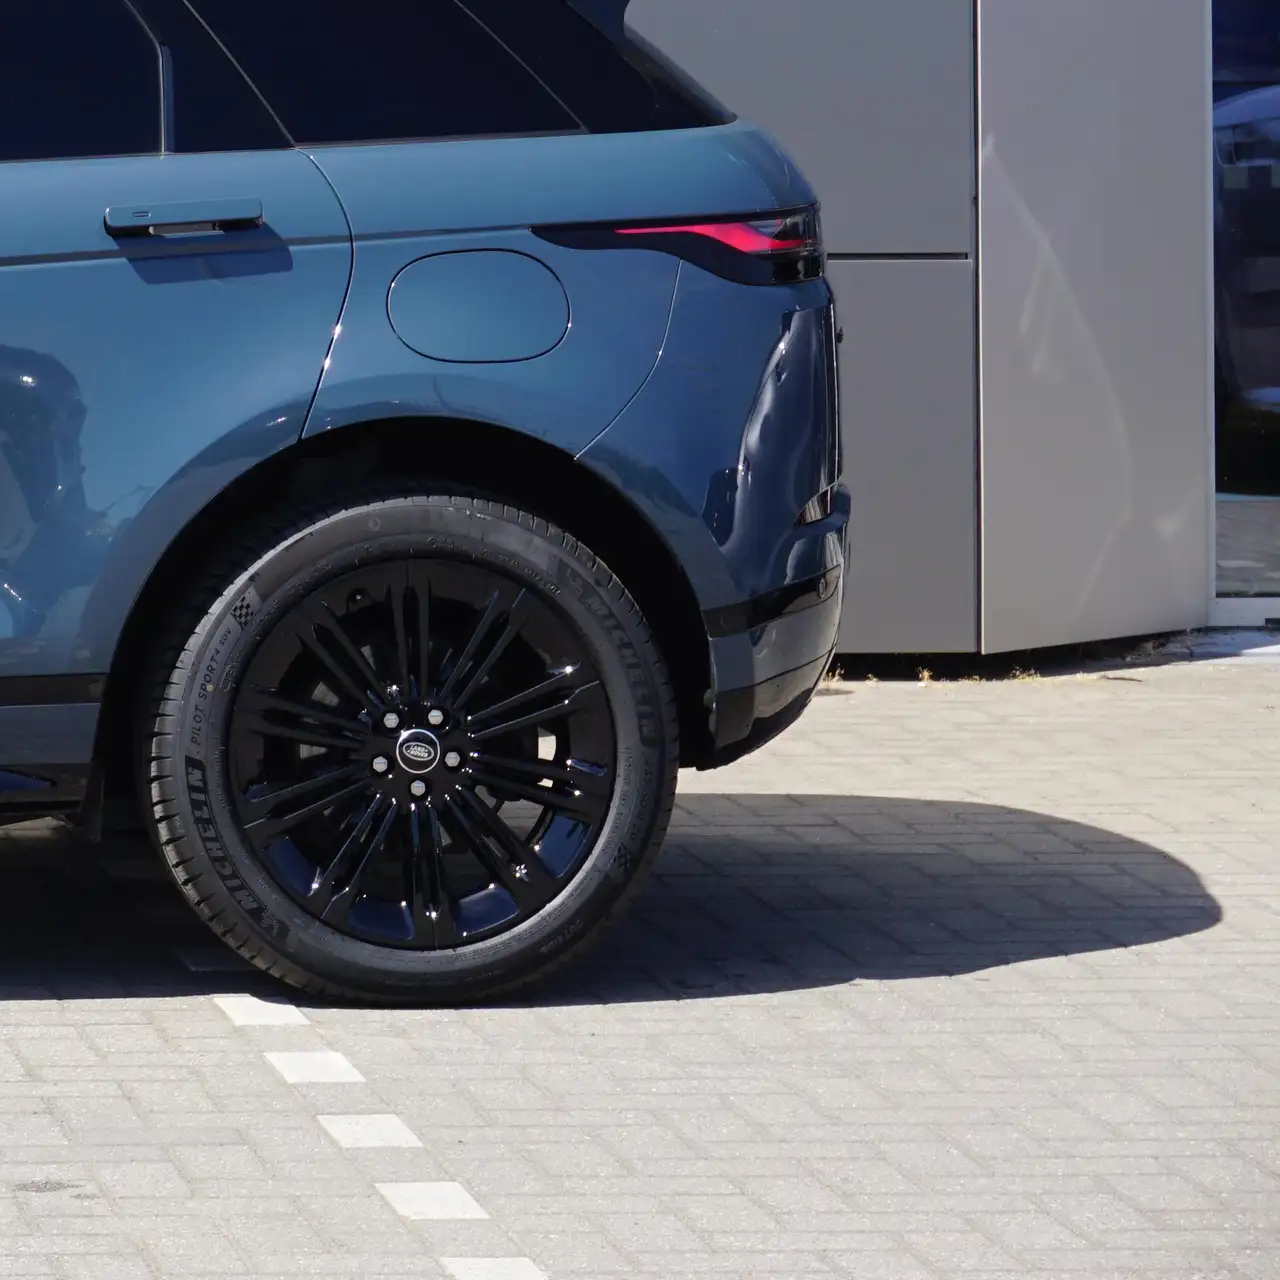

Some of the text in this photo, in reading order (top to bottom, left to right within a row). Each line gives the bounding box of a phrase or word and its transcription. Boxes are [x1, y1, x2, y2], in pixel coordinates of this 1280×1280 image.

[190, 704, 205, 747] PILOT
[218, 627, 232, 647] SUV
[585, 595, 658, 739] MICHELIN
[187, 766, 260, 911] MICHELIN
